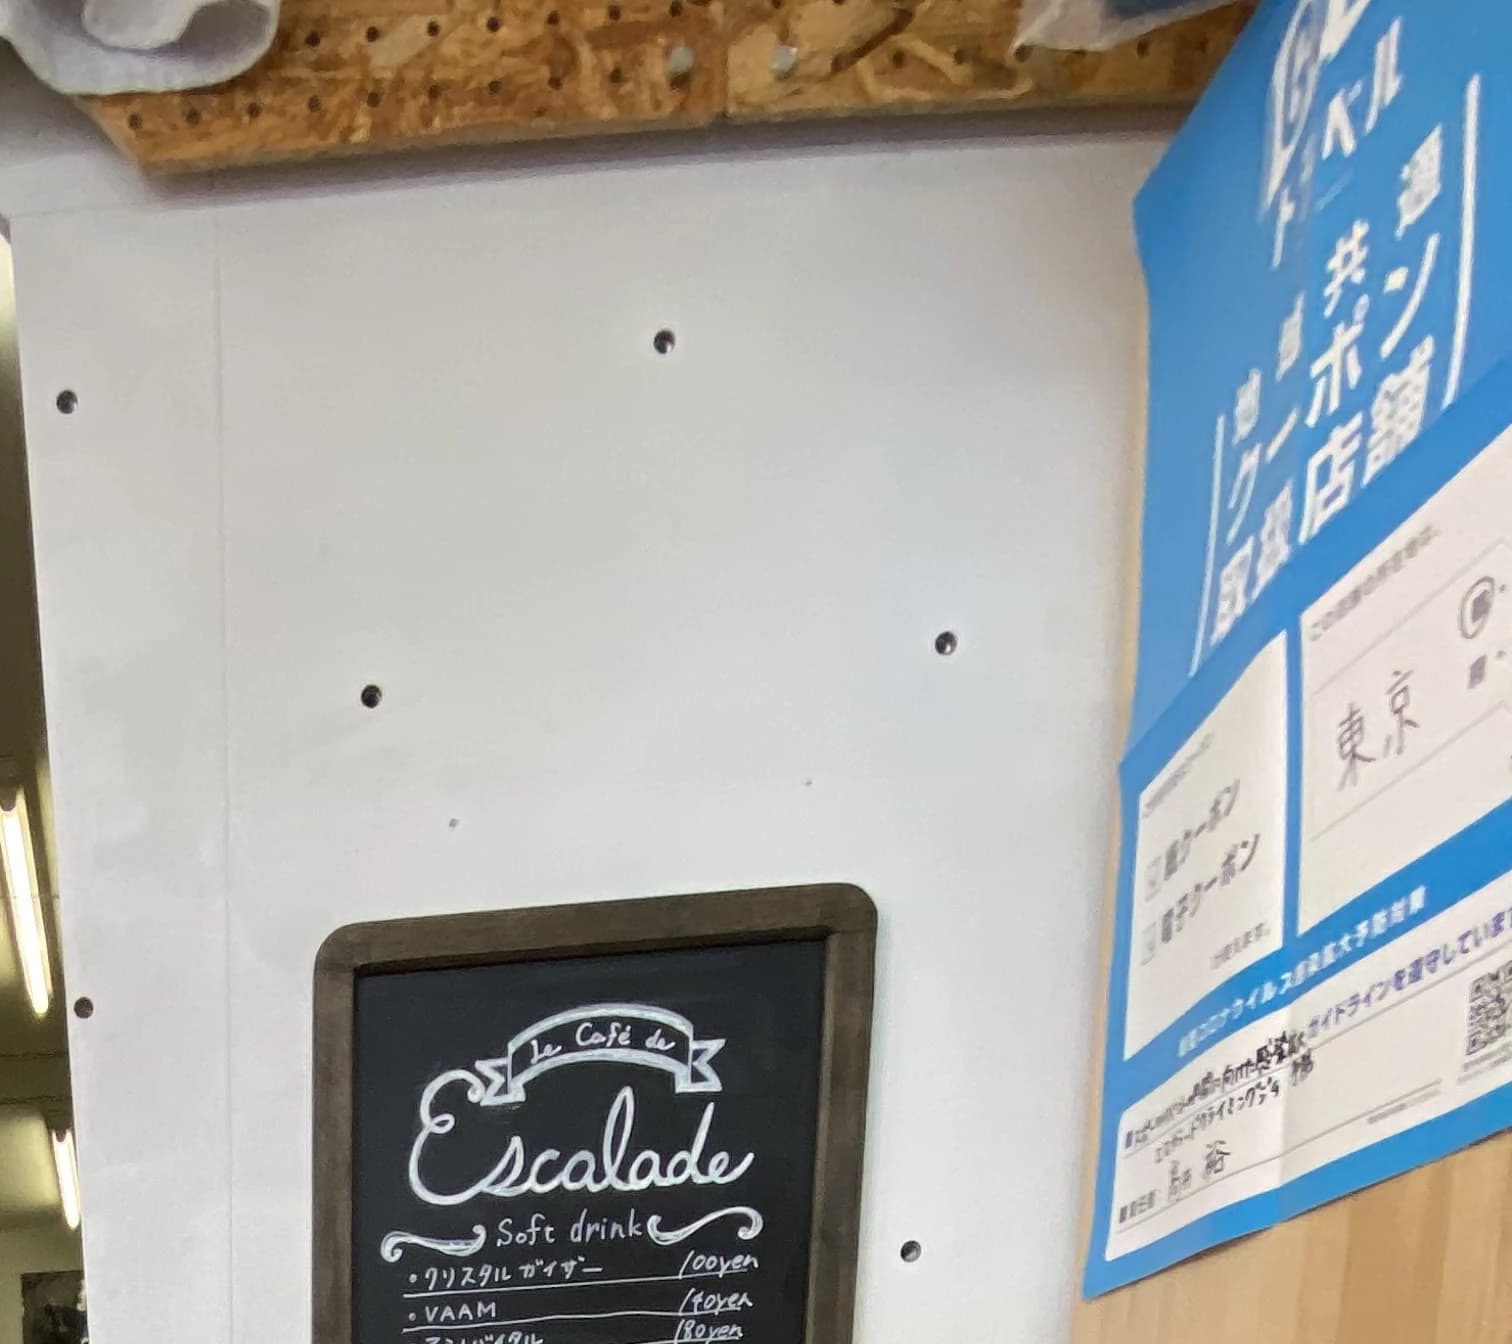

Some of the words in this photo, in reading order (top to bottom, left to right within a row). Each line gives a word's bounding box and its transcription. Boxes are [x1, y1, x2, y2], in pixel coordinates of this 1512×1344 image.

[1226, 233, 1440, 546] クーポン
[1338, 669, 1420, 792] 東京
[530, 1040, 561, 1064] Le
[575, 1022, 631, 1048] Café
[646, 1029, 675, 1050] de
[409, 1069, 754, 1205] Escalade
[497, 1213, 555, 1247] Soft
[570, 1208, 643, 1242] drink
[678, 1250, 759, 1279] 100yen
[425, 1302, 496, 1322] VAAM
[678, 1288, 753, 1316] 140yen
